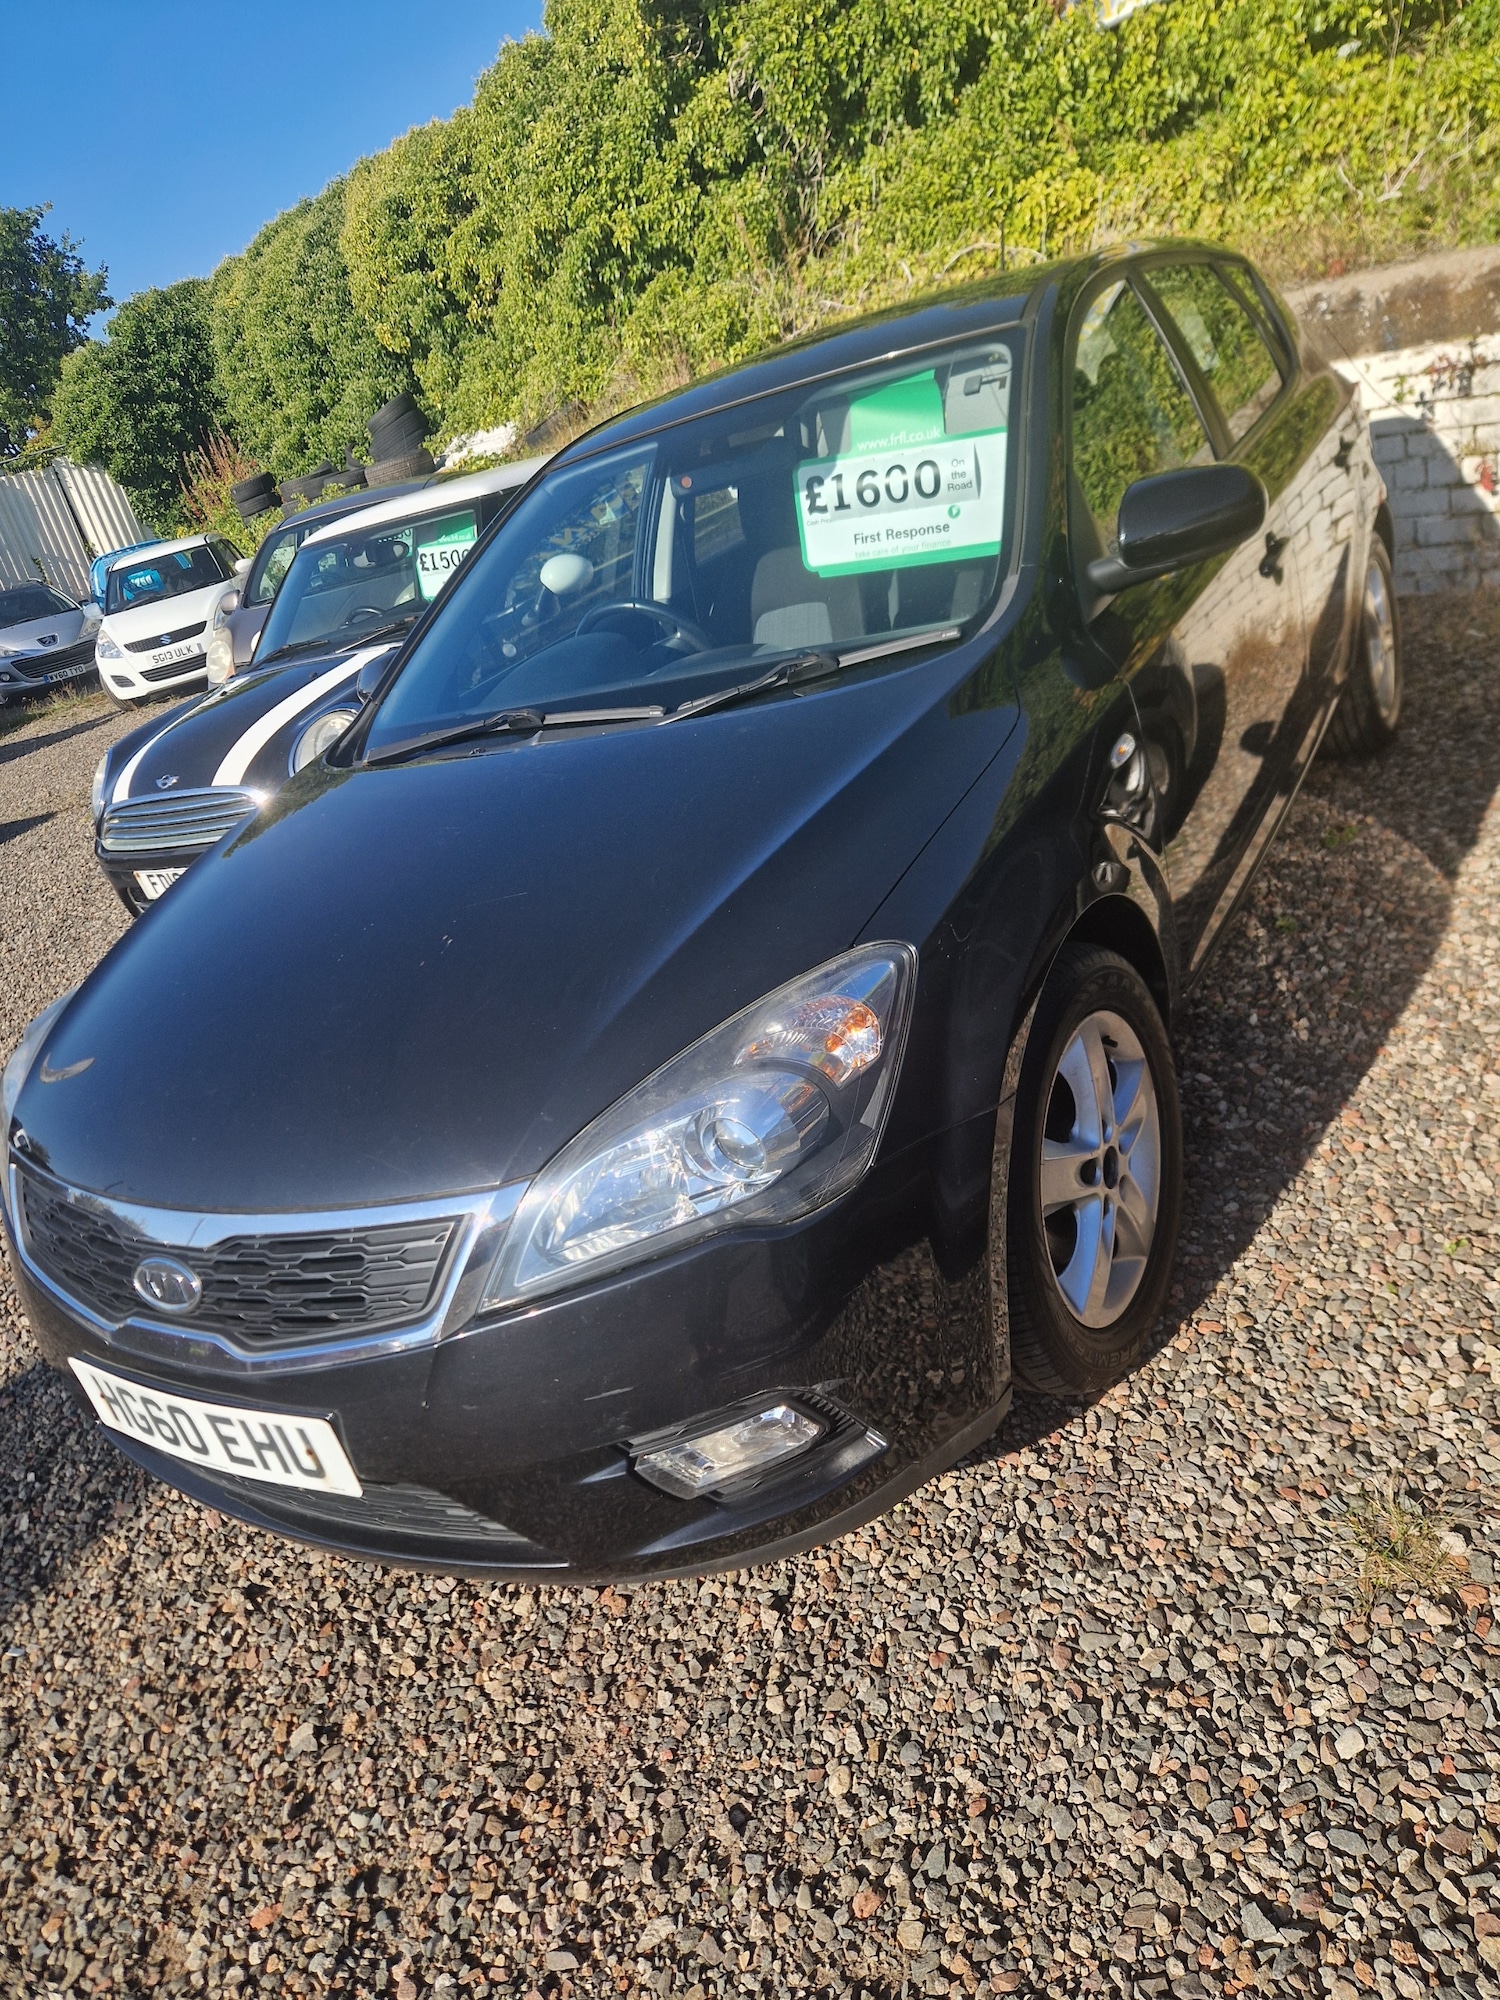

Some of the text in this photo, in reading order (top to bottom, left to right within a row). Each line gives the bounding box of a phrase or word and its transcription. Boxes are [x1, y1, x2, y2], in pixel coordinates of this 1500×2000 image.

[857, 426, 942, 451] www.frfl.co.uk
[951, 458, 966, 468] On
[951, 470, 967, 479] the
[805, 459, 942, 516] £1600
[947, 480, 973, 491] Road
[854, 531, 882, 545] First
[886, 522, 951, 542] Response
[891, 545, 900, 553] of
[901, 544, 920, 555] your
[921, 539, 951, 550] finance
[152, 646, 194, 665] SG13 ULK
[89, 1373, 326, 1479] HG60 EHU
